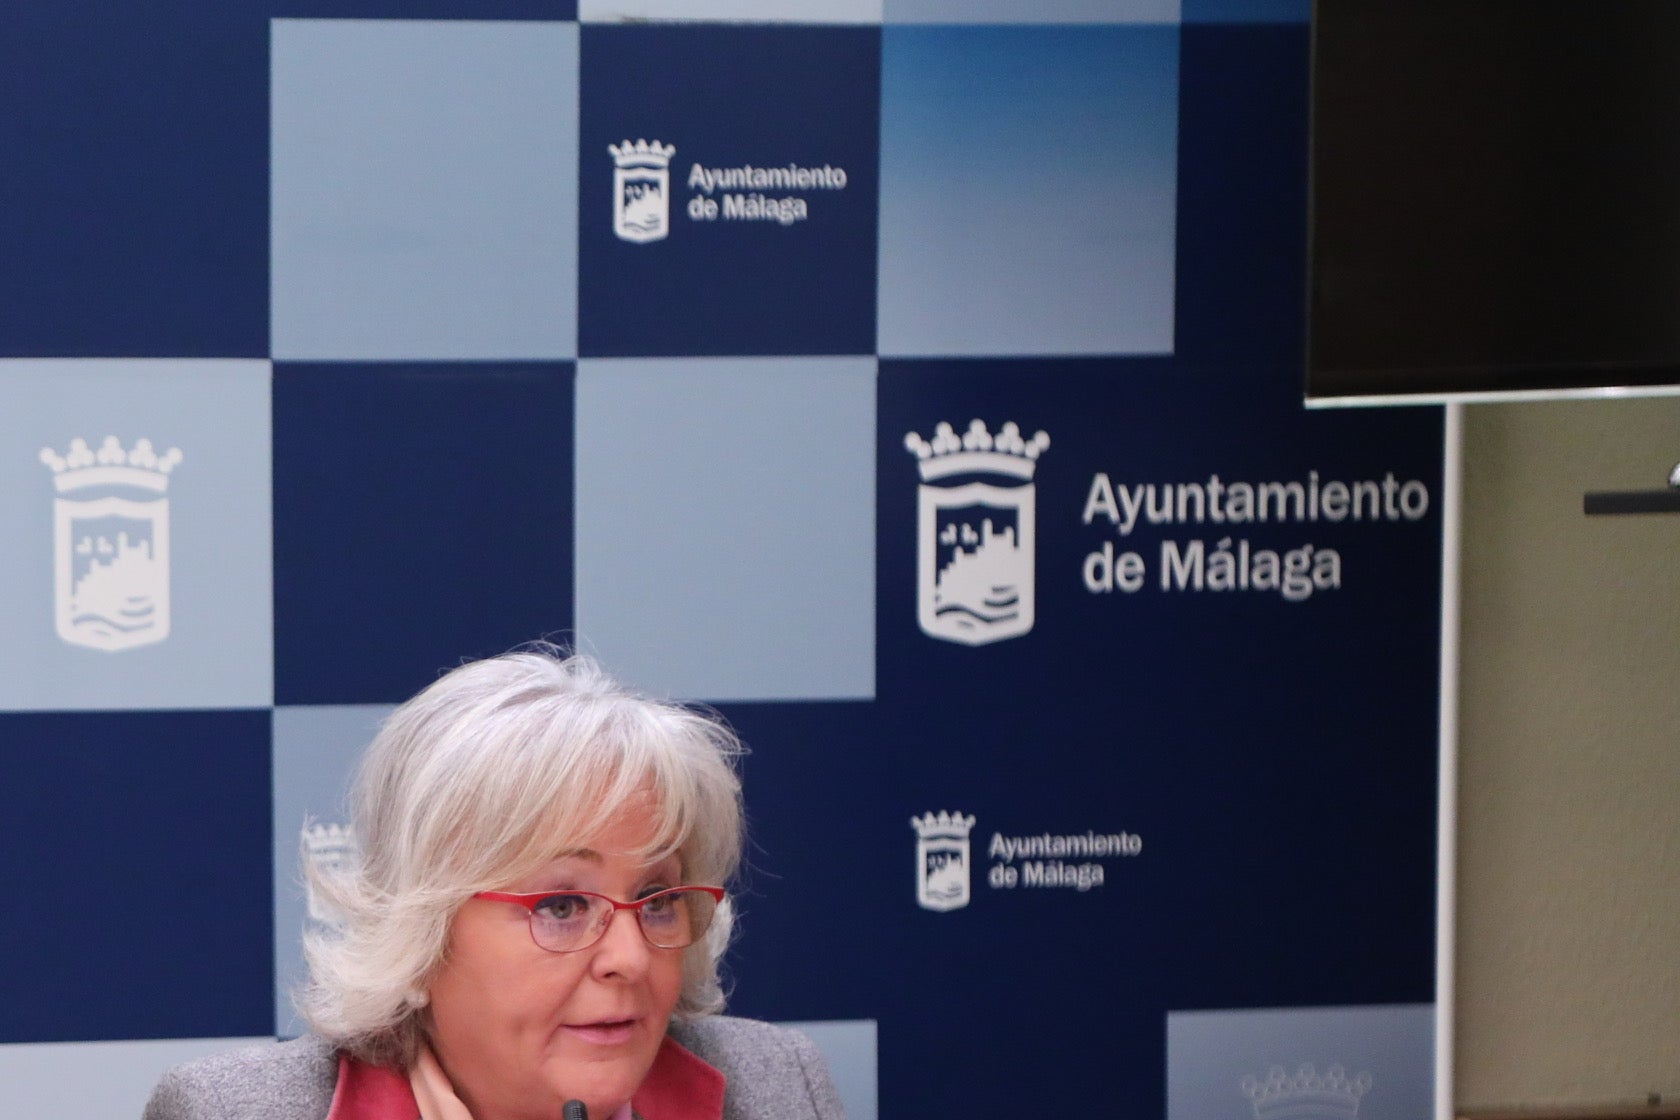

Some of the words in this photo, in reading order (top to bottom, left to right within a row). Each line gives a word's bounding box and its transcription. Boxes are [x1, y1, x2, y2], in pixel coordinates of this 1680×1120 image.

[686, 162, 848, 194] Ayuntamiento
[686, 194, 720, 221] de
[721, 192, 809, 226] Málaga
[1082, 470, 1430, 536] Ayuntamiento
[1082, 540, 1146, 593] de
[1159, 536, 1342, 601] Málaga
[988, 830, 1143, 864] Ayuntamiento
[988, 862, 1018, 889] de
[1021, 859, 1105, 892] Málaga
